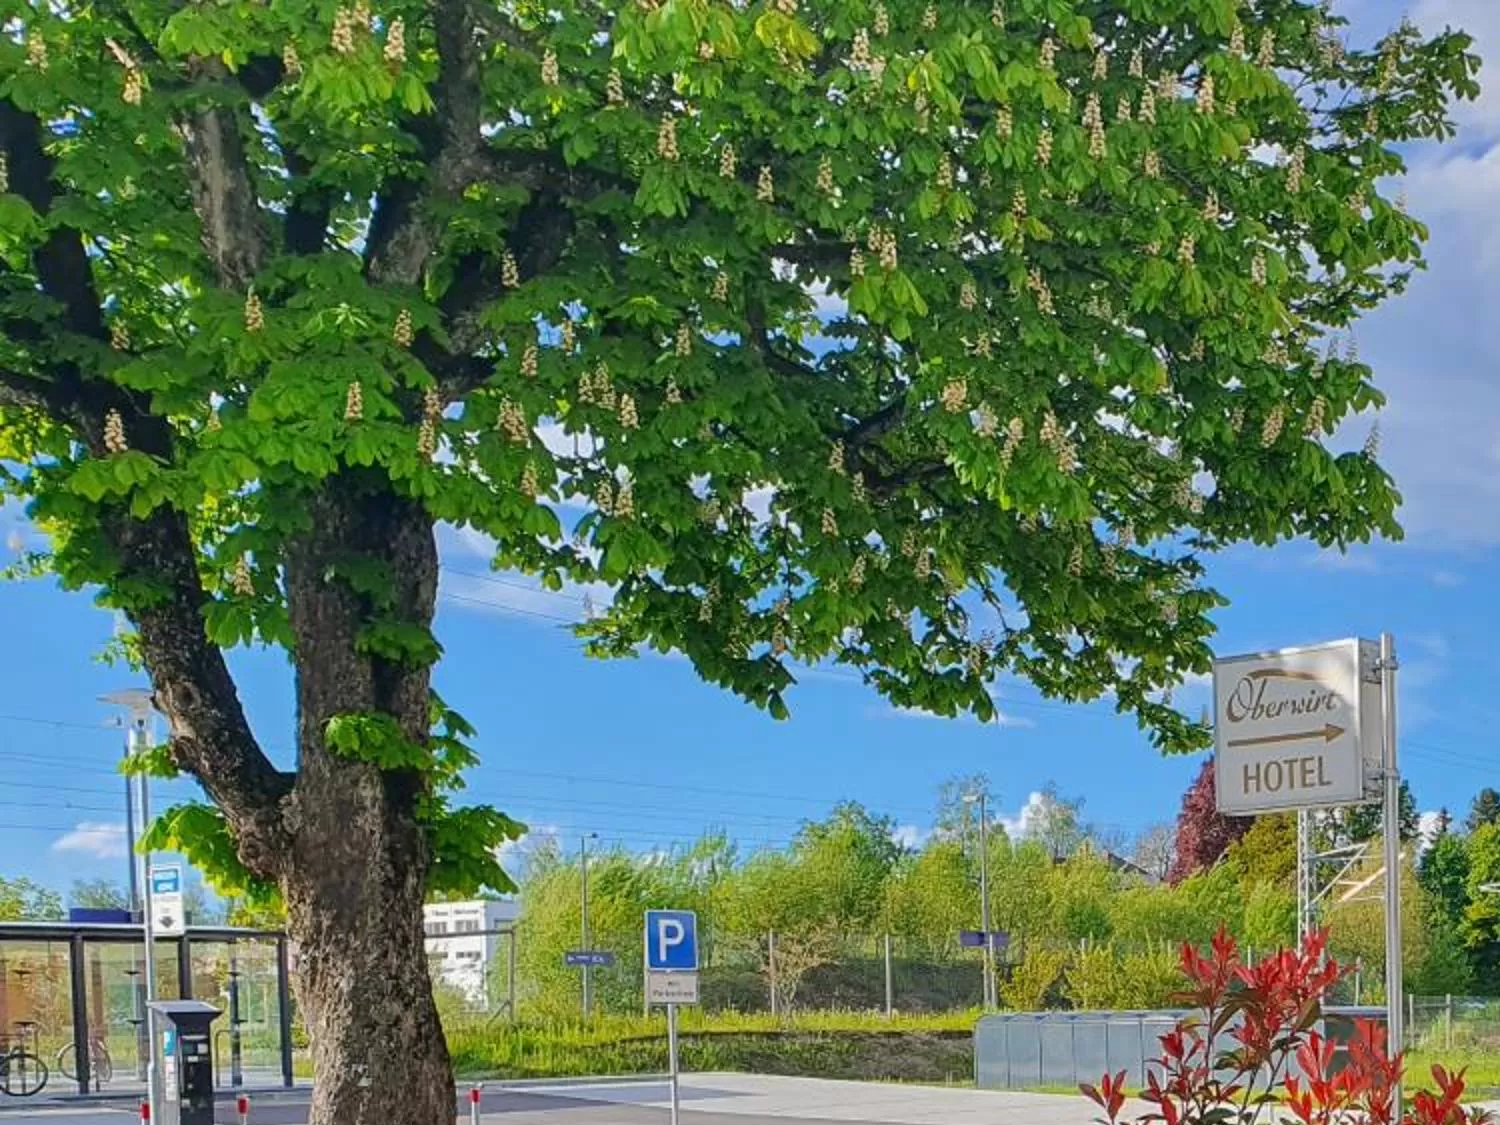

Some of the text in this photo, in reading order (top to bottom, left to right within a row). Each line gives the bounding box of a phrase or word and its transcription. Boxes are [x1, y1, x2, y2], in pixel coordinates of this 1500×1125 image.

[1227, 676, 1337, 722] Oberwirt
[1243, 756, 1332, 794] HOTEL
[659, 919, 684, 962] P
